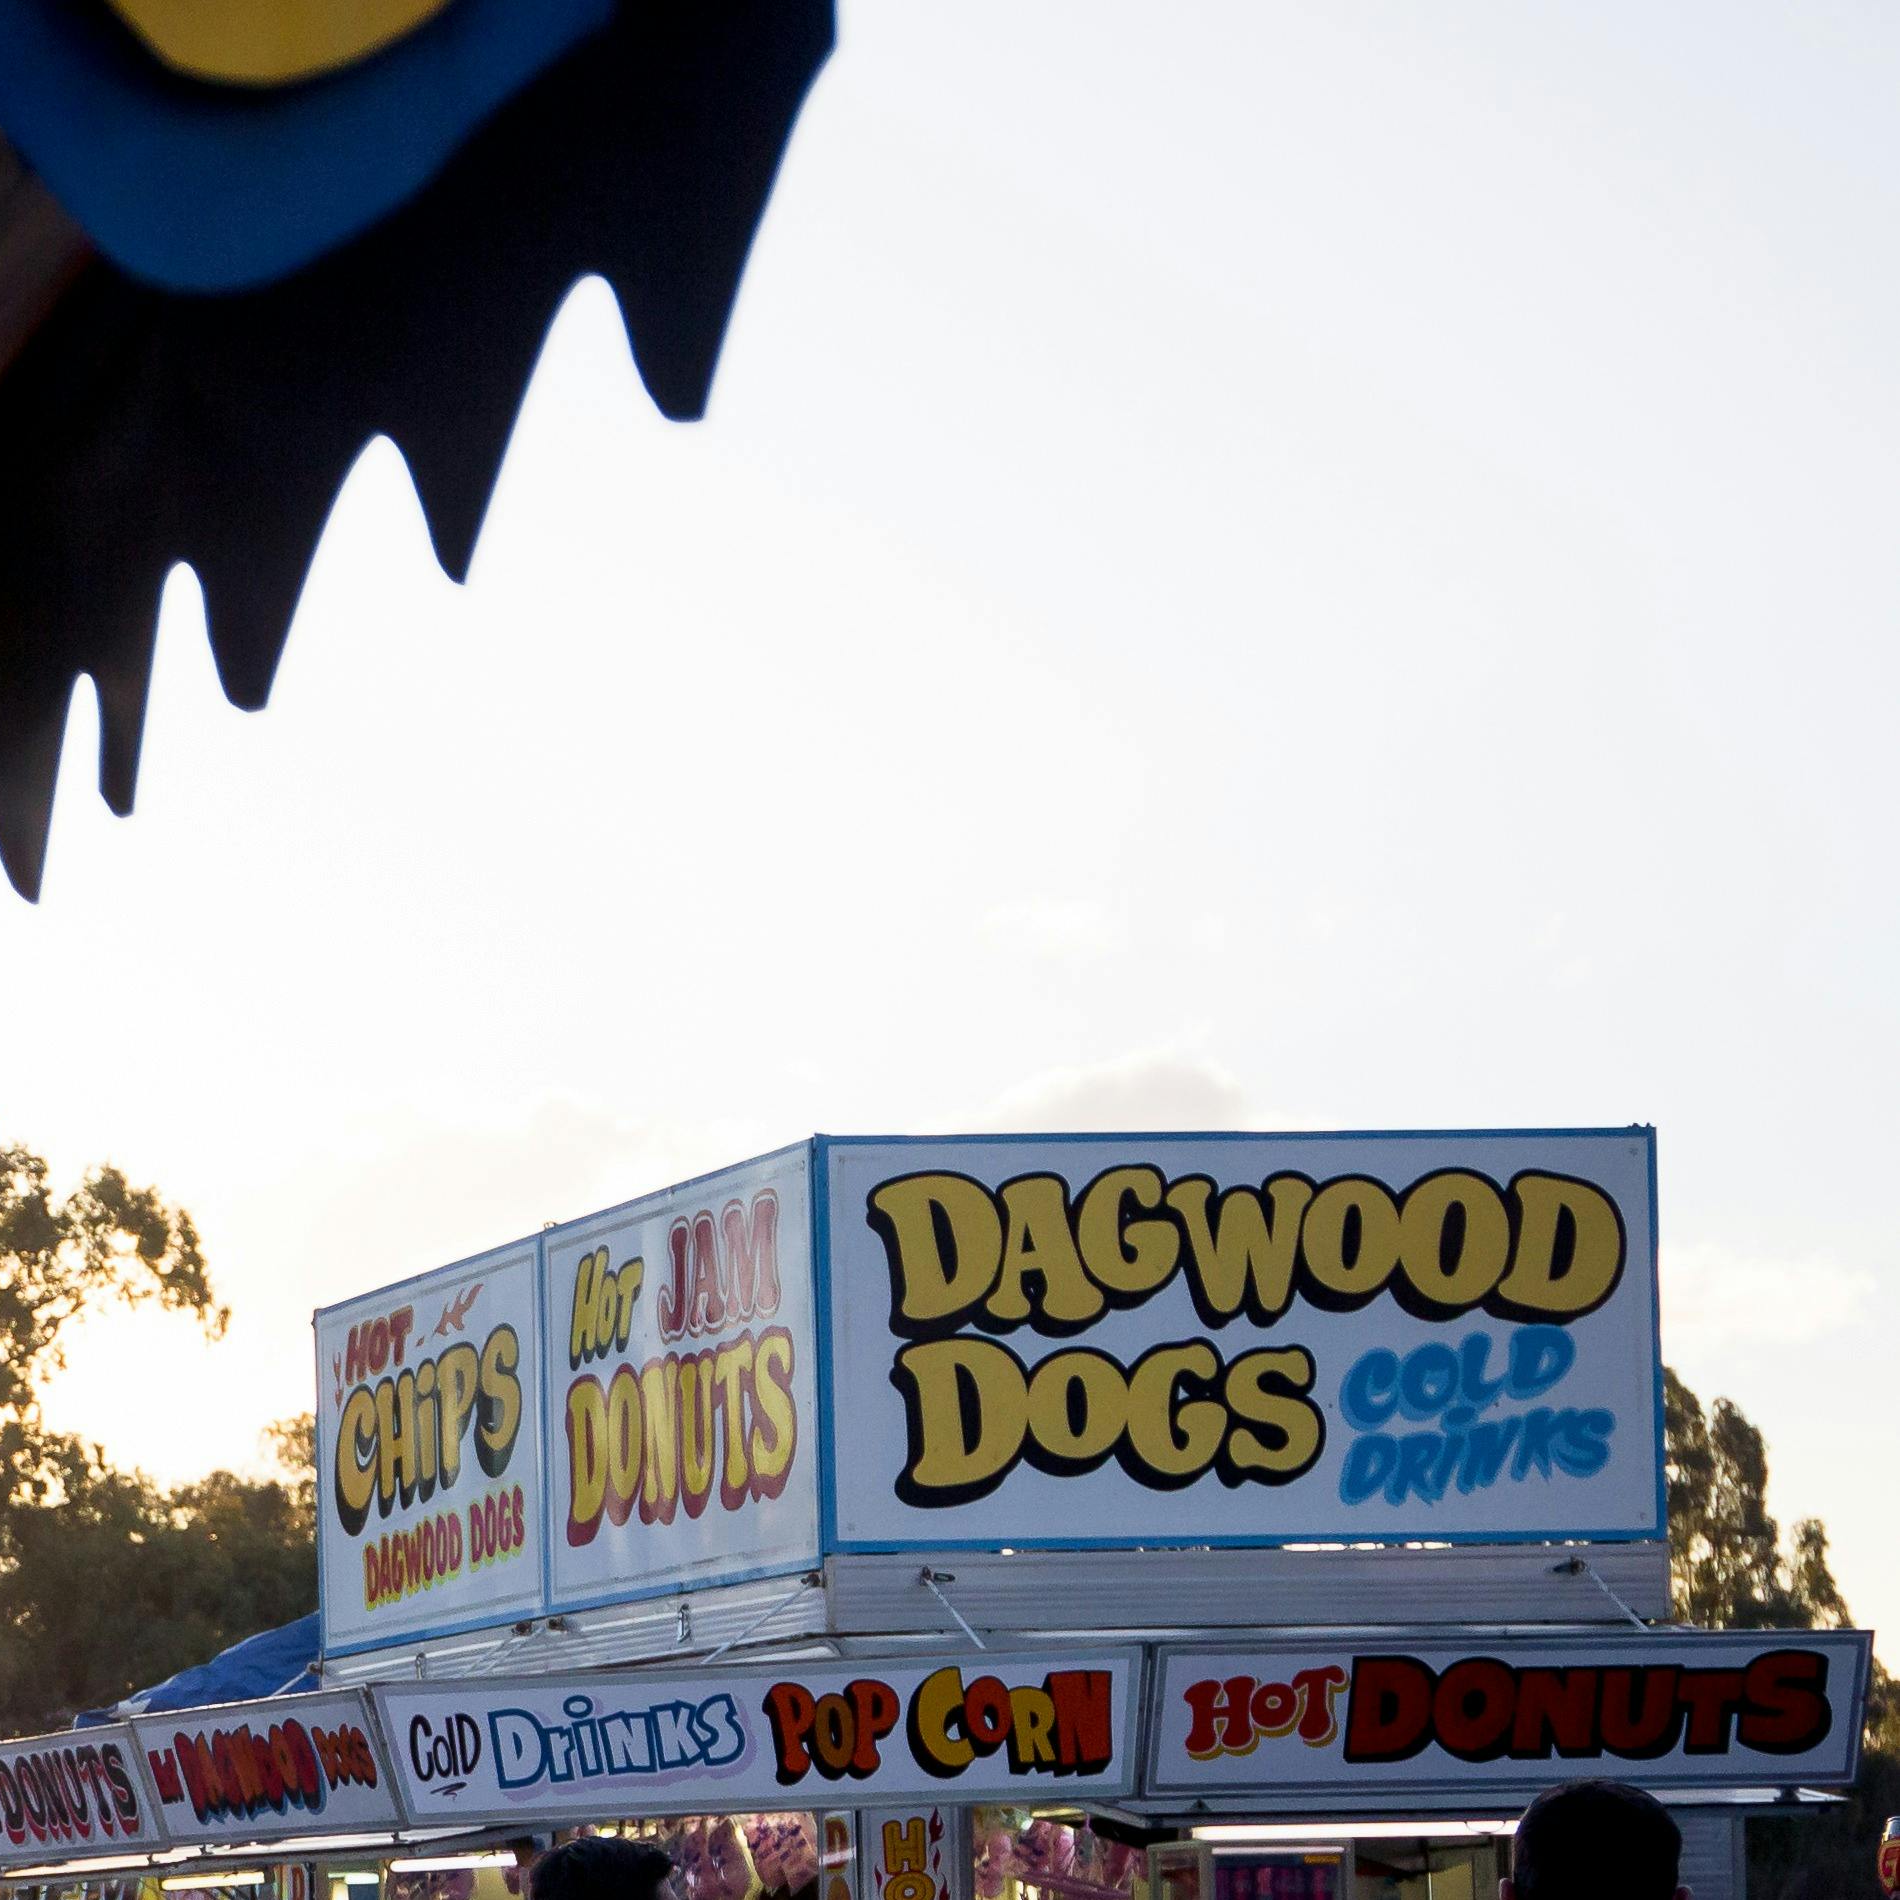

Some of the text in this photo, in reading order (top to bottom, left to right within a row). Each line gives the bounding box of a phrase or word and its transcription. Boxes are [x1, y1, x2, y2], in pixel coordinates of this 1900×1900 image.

[657, 1187, 781, 1344] JAM
[866, 1164, 1626, 1338] DAGWOOD
[346, 1306, 415, 1387] HOT
[893, 1324, 1577, 1509] DOGS COLD
[565, 1325, 798, 1548] DONUTS
[363, 1485, 525, 1613] DAGWOOD DOGS
[762, 1678, 900, 1786] POP
[906, 1666, 1112, 1779] CORN
[1183, 1649, 1832, 1764] HOT DONUTS
